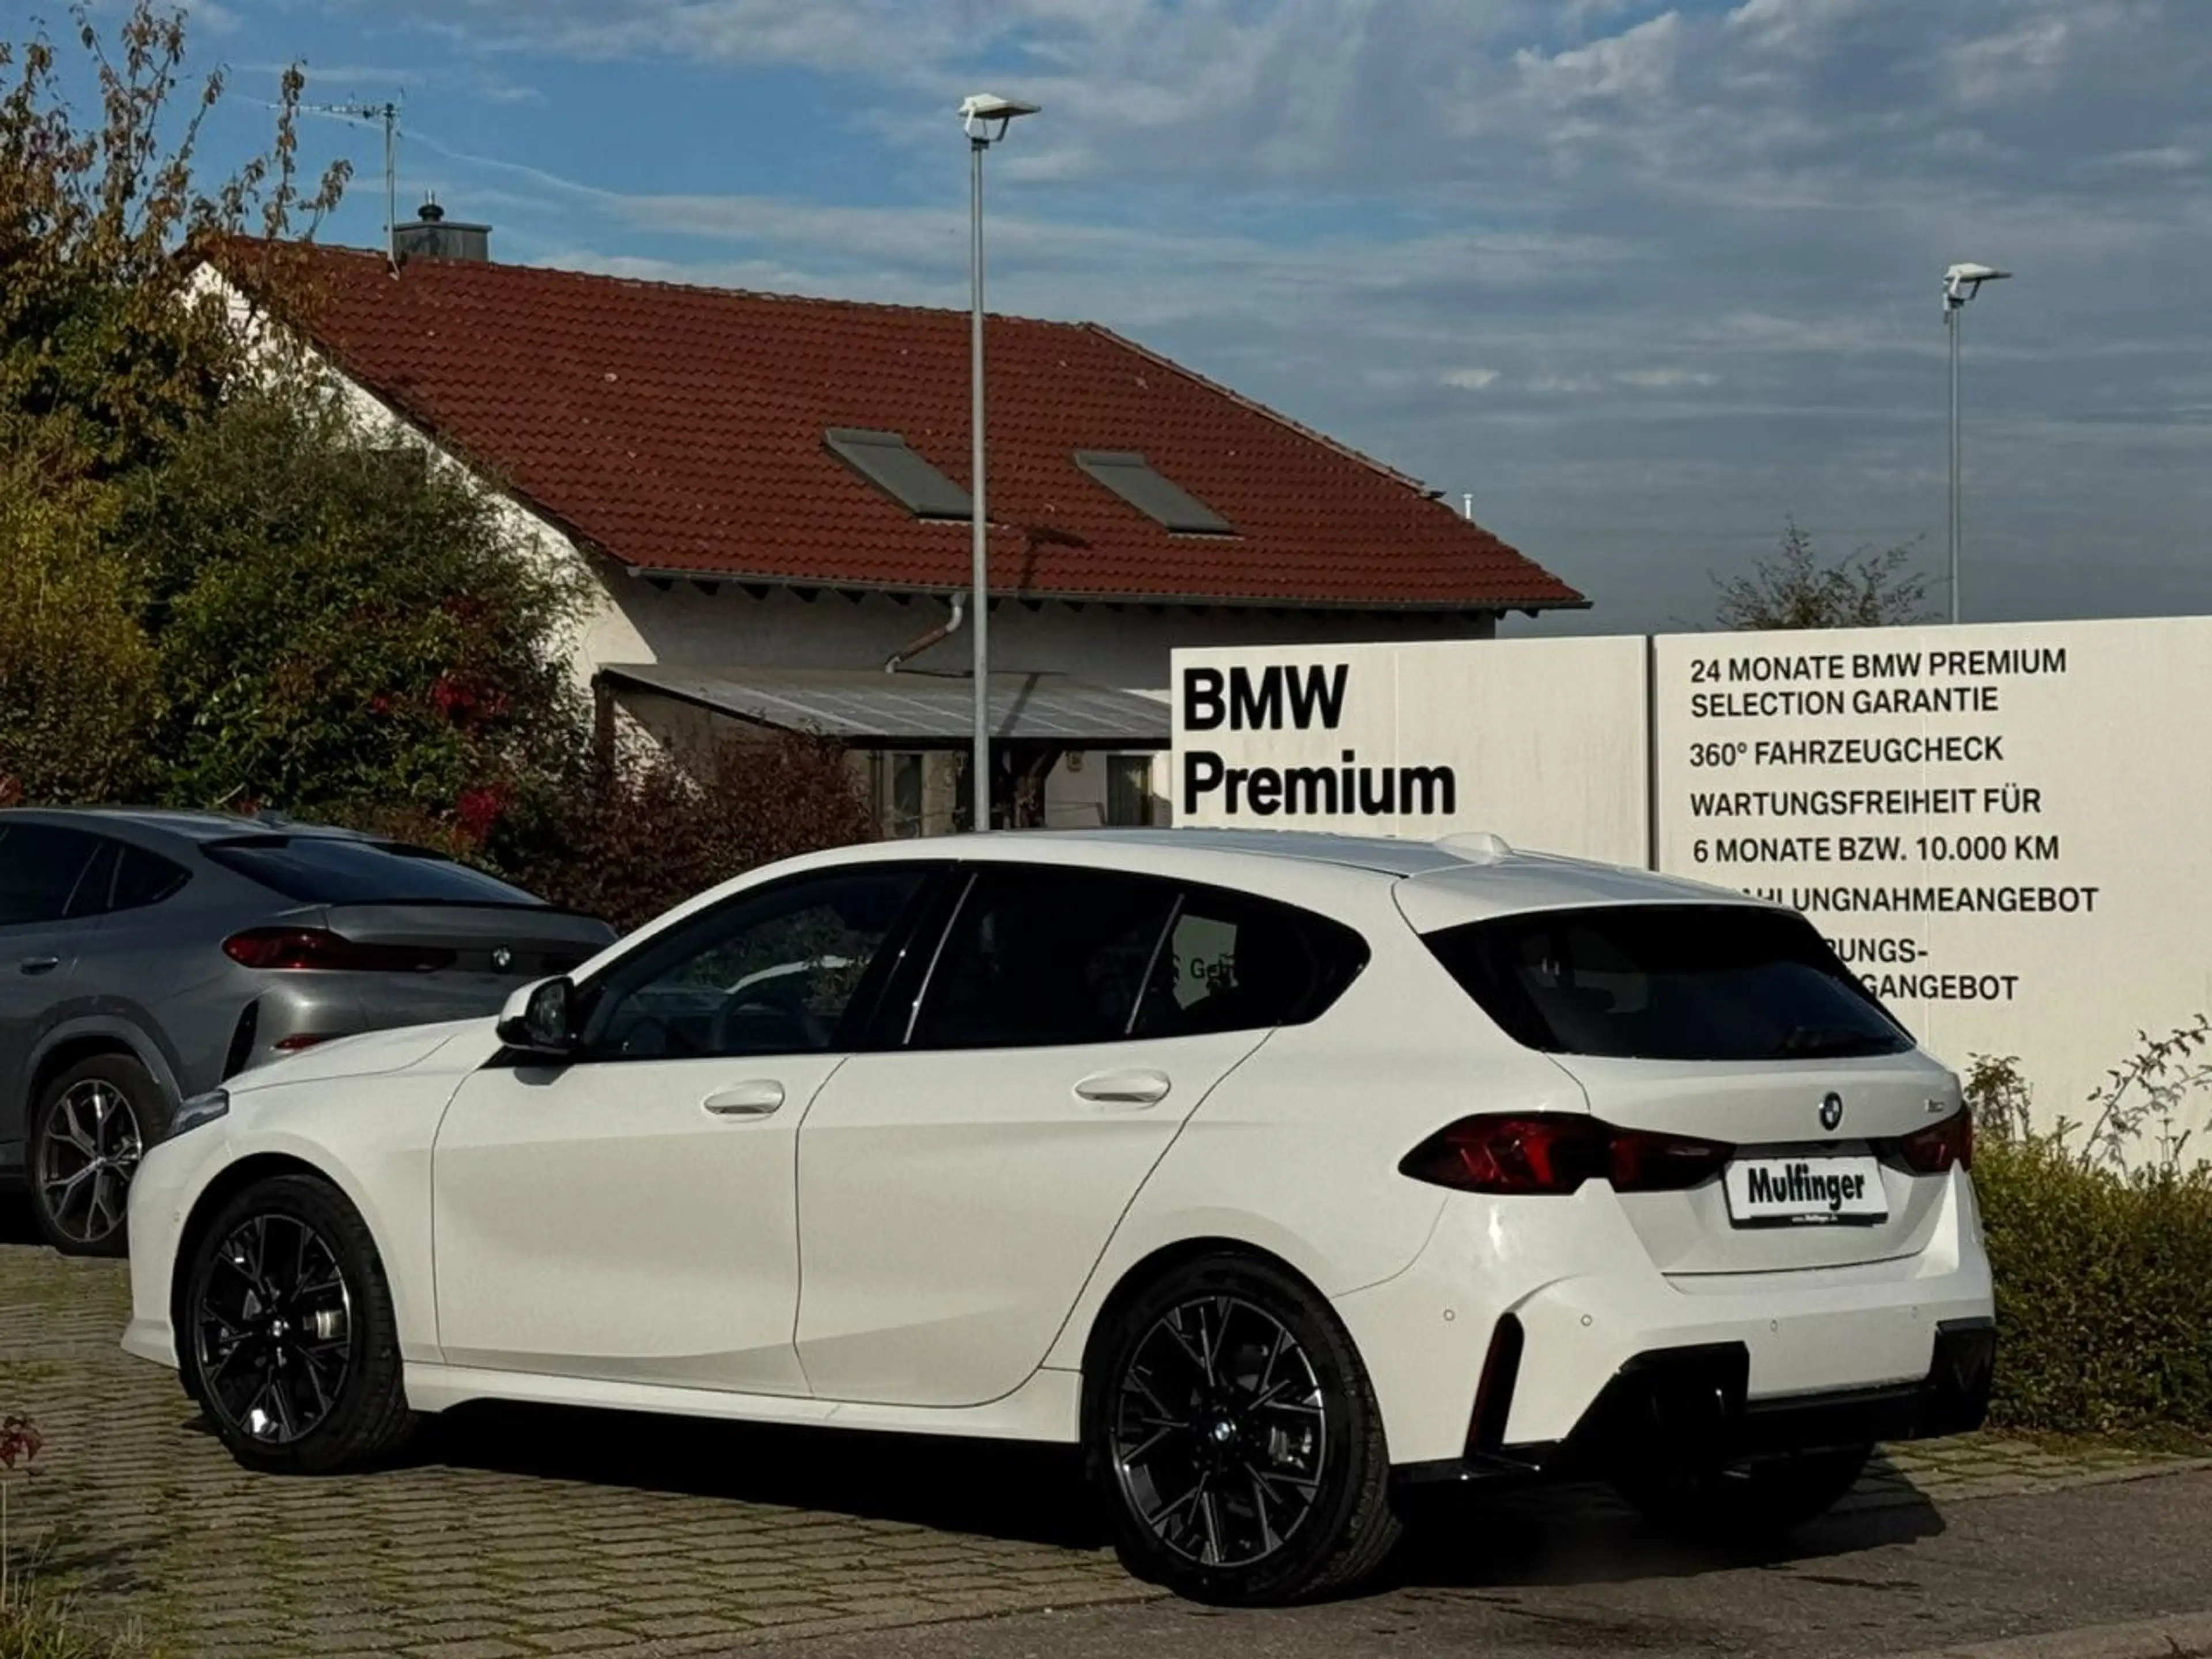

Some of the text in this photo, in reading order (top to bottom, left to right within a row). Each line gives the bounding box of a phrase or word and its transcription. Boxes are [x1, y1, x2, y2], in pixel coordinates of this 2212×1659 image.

[1690, 648, 2066, 683] 24 MONATE BMW PREMIUM
[1183, 664, 1349, 732] BMW
[1691, 686, 1998, 718] SELECTION GARANTIE
[1690, 736, 2003, 767] 360° FAHRZEUGCHECK
[1184, 749, 1456, 816] Premium
[1690, 783, 2041, 816] WARTUNGSFREIHEIT FÜR
[1694, 835, 2059, 863] 6 MONATE BZW. 10.000 KM
[1748, 1163, 1865, 1211] Mulfinger
